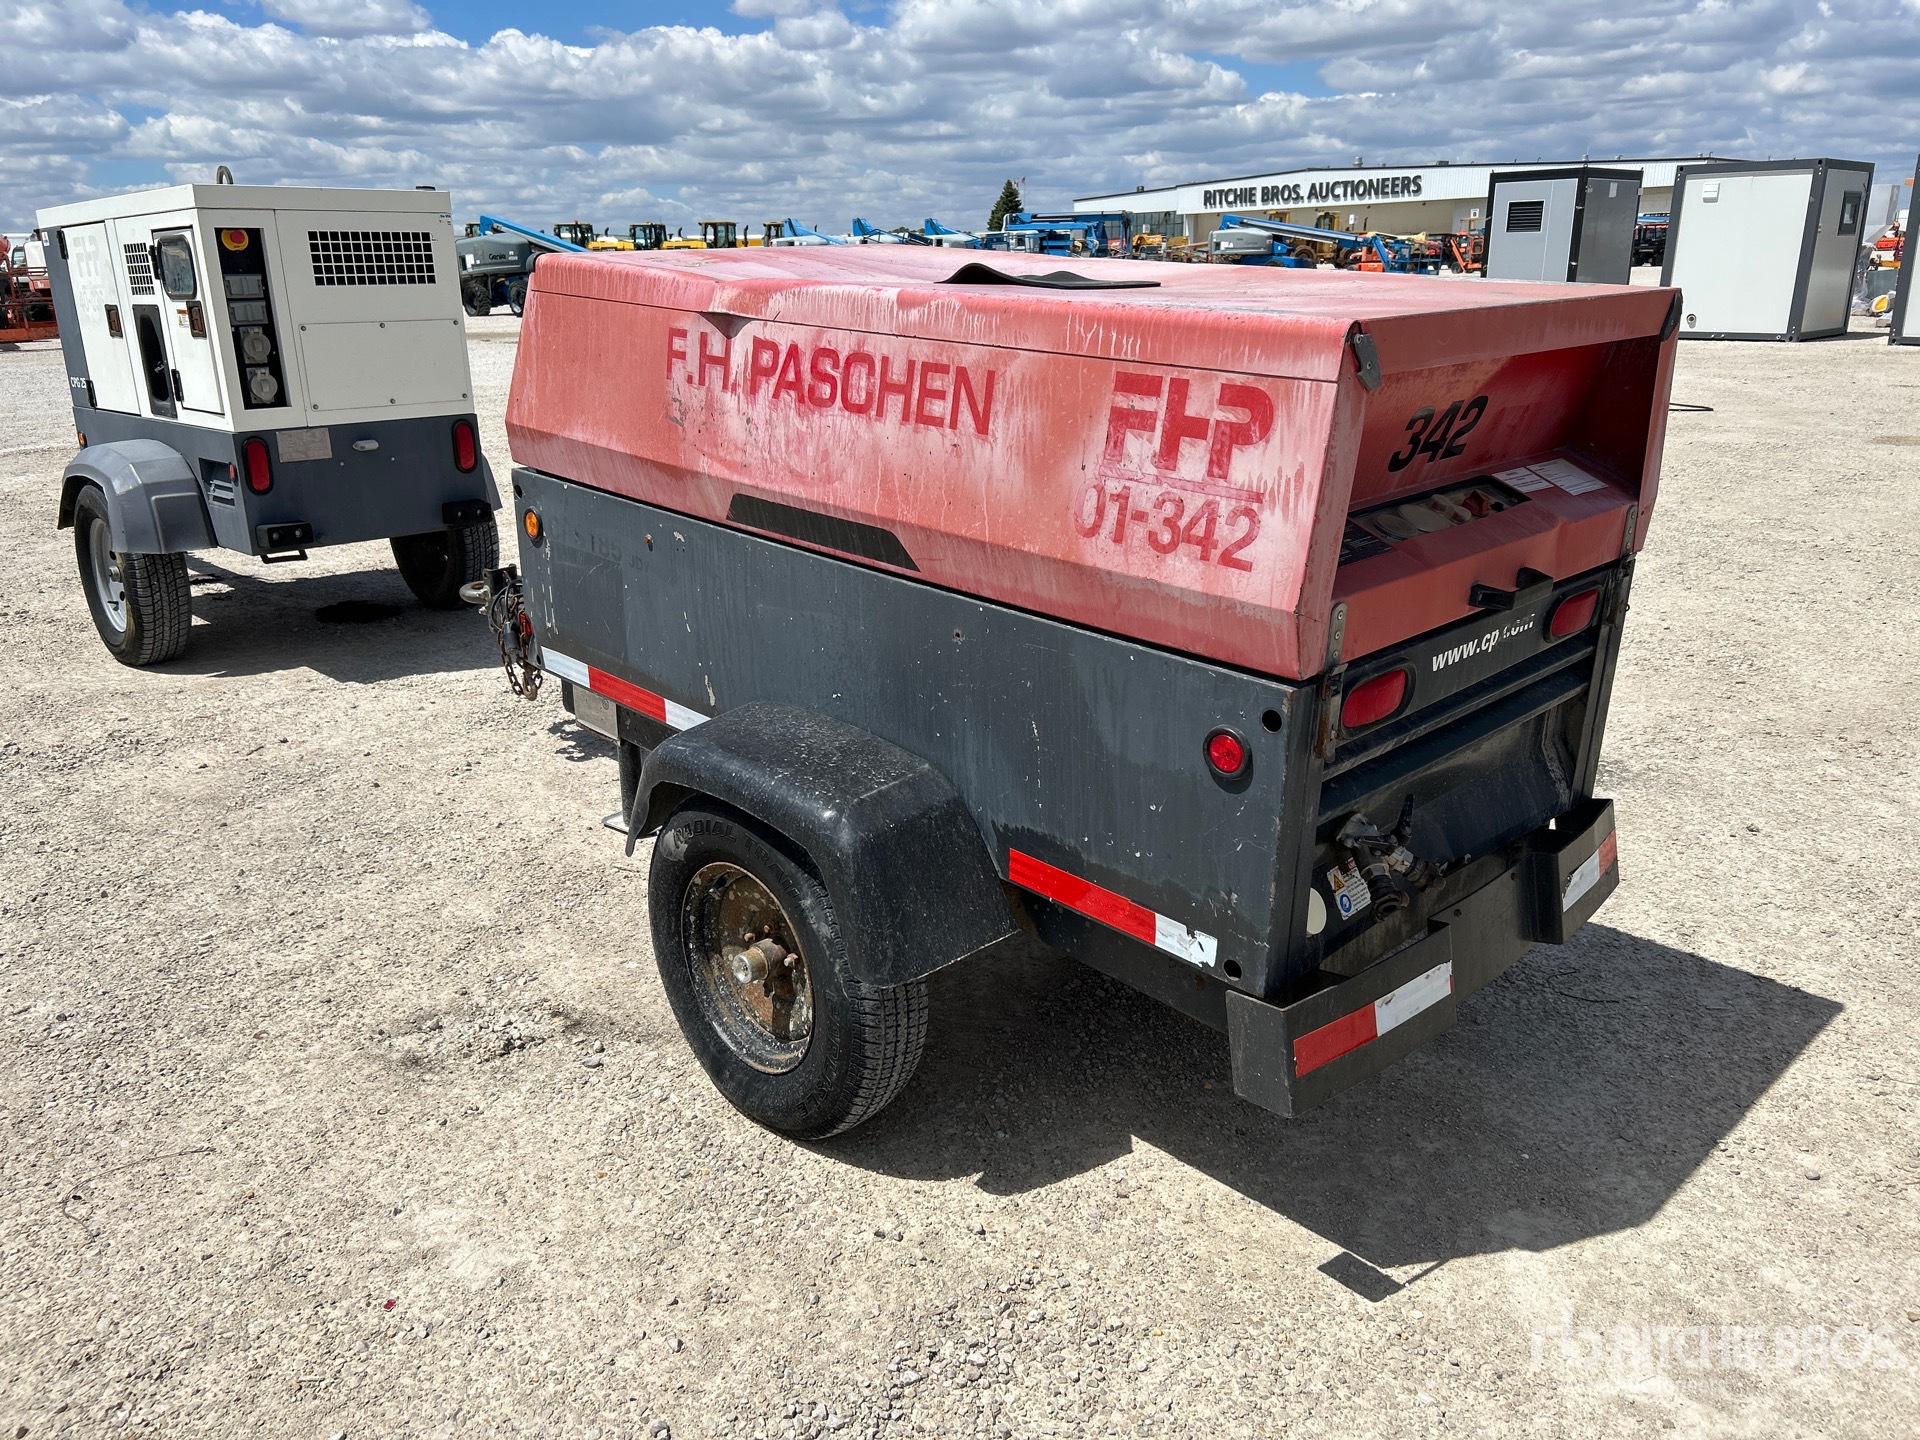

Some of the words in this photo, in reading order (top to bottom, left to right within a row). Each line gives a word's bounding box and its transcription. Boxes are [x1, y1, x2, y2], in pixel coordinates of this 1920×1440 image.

[1203, 186, 1257, 207] RITCHIE
[1261, 183, 1305, 203] BROS.
[1307, 175, 1422, 200] AUCTIONEERS
[750, 335, 996, 435] PASCHEN
[1104, 371, 1274, 479] FHP
[1388, 395, 1489, 472] 342
[1074, 480, 1261, 573] 01-342
